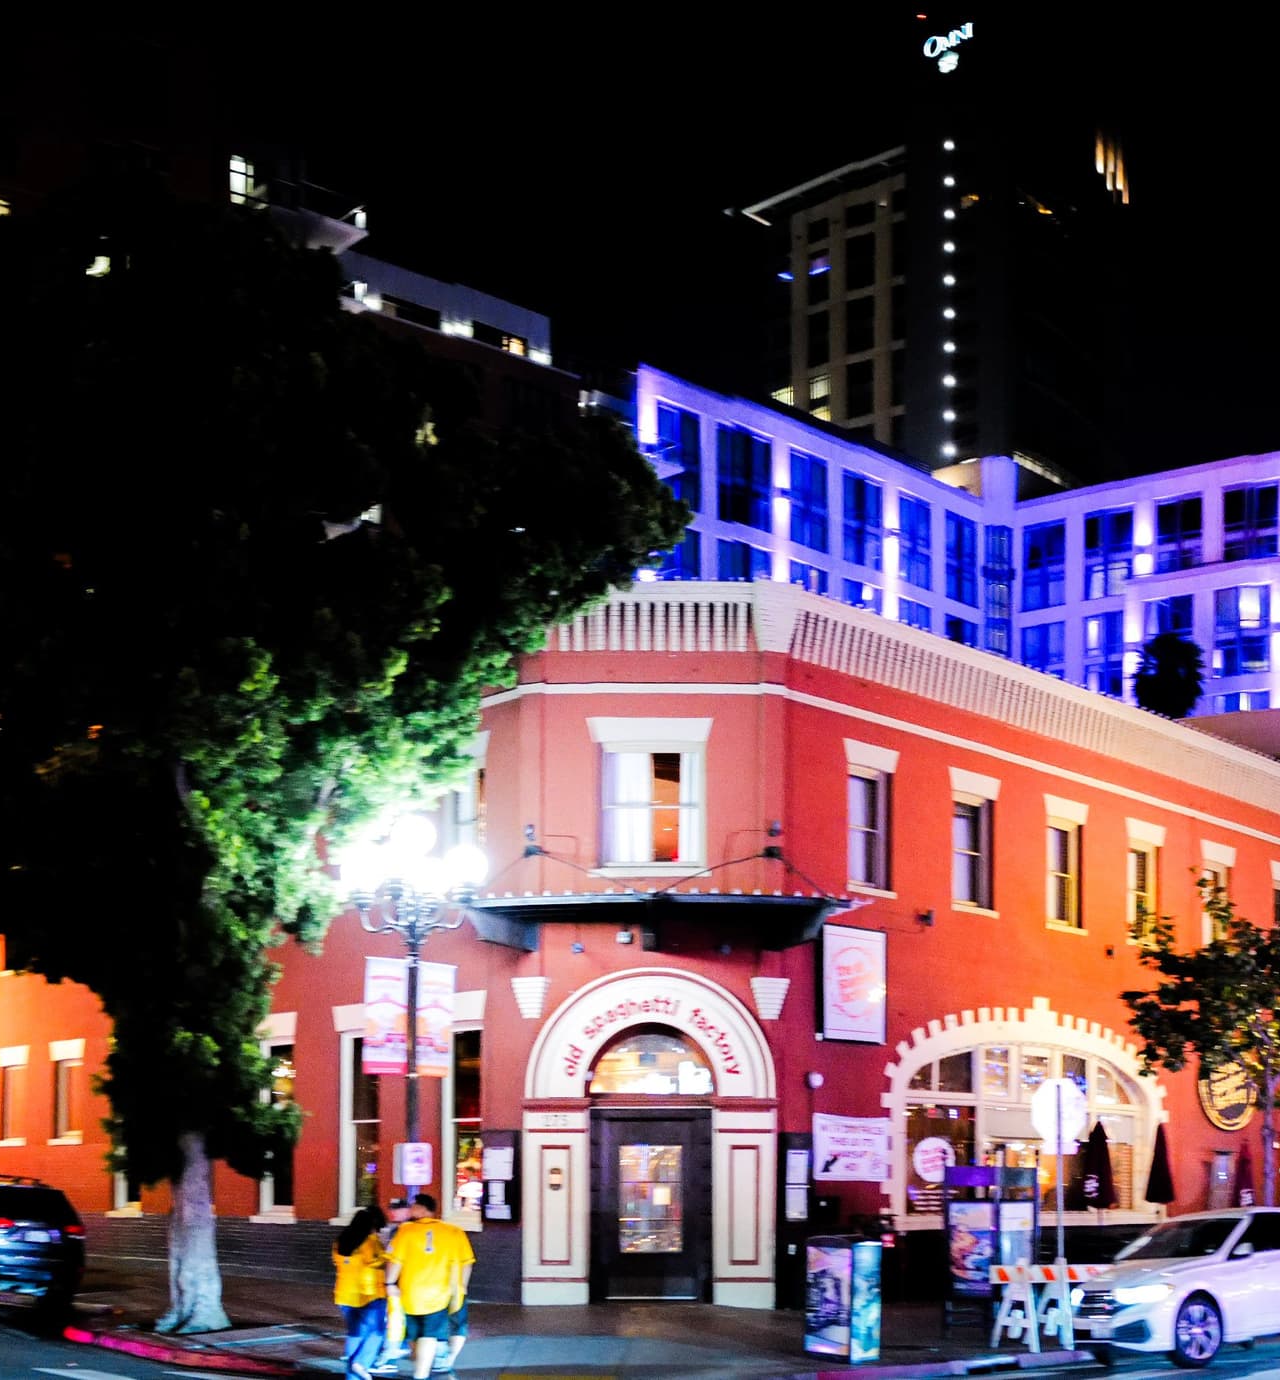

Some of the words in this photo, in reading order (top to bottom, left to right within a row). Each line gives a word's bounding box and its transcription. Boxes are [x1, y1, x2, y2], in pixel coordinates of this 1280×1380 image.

[563, 1043, 584, 1077] old
[584, 996, 681, 1040] spaghetti
[689, 1008, 741, 1075] factory
[424, 1230, 434, 1254] 1
